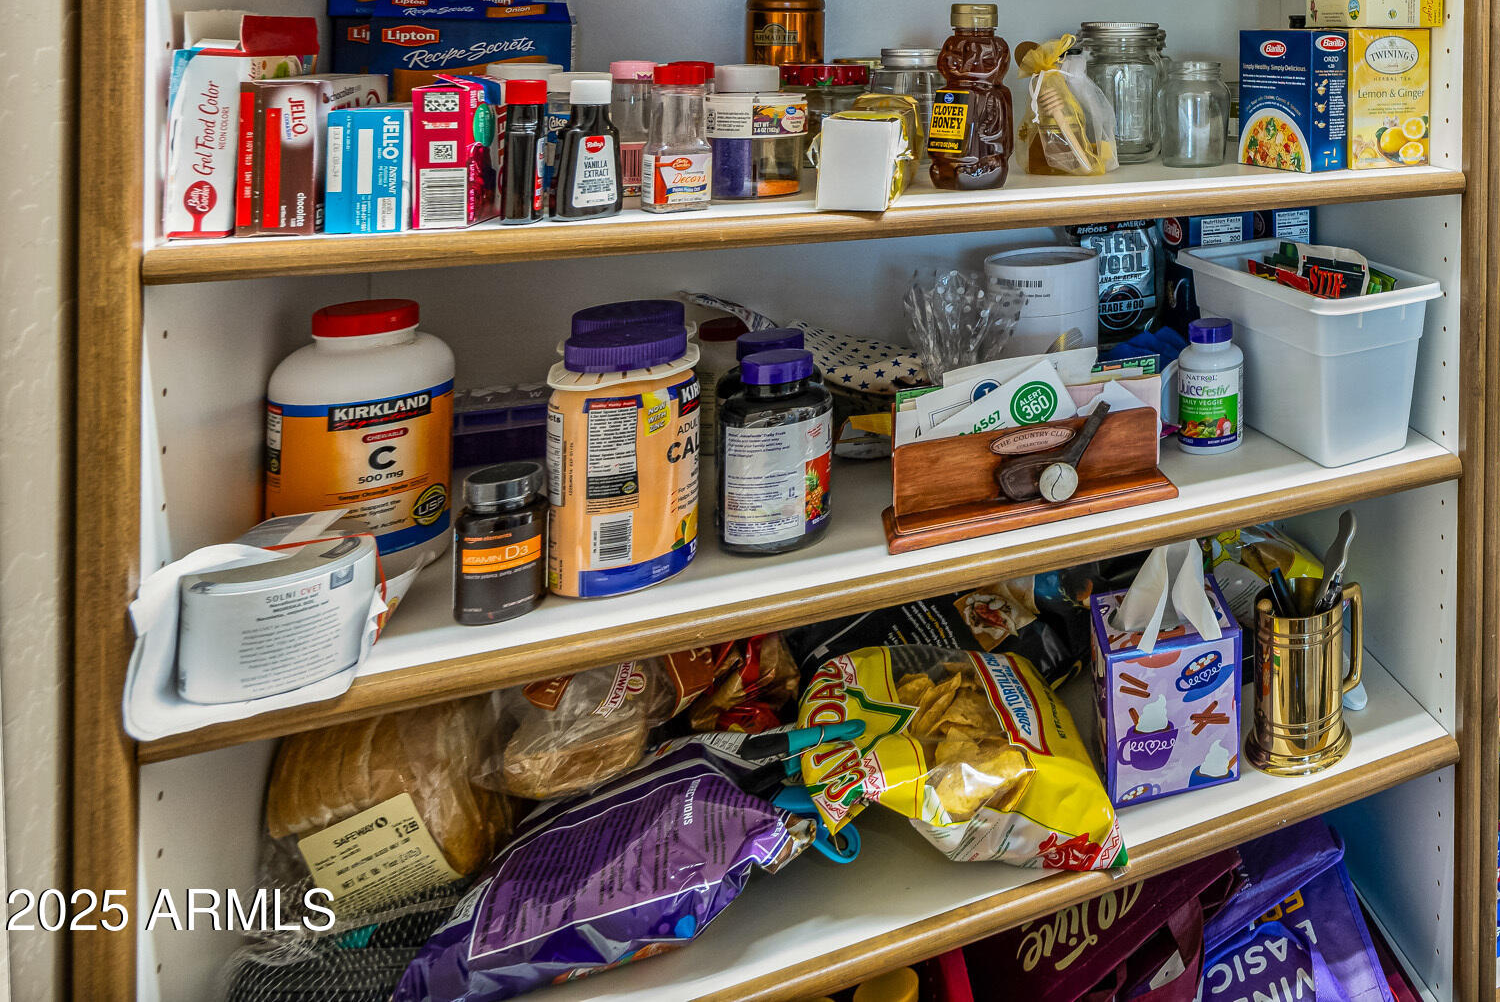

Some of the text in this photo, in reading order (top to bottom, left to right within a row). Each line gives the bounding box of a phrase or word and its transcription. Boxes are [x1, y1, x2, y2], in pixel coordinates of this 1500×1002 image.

[504, 5, 531, 13] Onion
[386, 30, 436, 42] Lipton
[1322, 37, 1345, 48] Barilla
[403, 37, 536, 69] Recipe Secrets
[1264, 44, 1285, 54] Barilla
[1369, 51, 1416, 62] TWININGS
[1357, 88, 1425, 100] Lemon Ginger
[933, 105, 964, 117] CLOVER
[192, 84, 220, 176] Gel Food Color
[932, 116, 963, 129] HONEY
[583, 160, 608, 169] VANILLA
[583, 169, 609, 179] EXTRACT
[672, 172, 707, 183] Decors
[187, 187, 200, 207] Betty
[197, 184, 212, 212] Crocker
[296, 192, 307, 227] chocolate
[1164, 218, 1180, 239] Barilla
[1089, 232, 1147, 254] STEEL
[1229, 234, 1241, 242] 200
[1186, 373, 1217, 381] NATROL
[1019, 388, 1043, 407] ALERT
[333, 394, 430, 422] KIRKLAND
[647, 401, 667, 416] NOW
[1021, 395, 1050, 420] 360
[647, 411, 667, 424] WITH
[649, 420, 666, 433] ZINC
[996, 430, 1049, 450] THE COUNTRY
[368, 445, 398, 470] C
[358, 470, 404, 485] 500 mg
[417, 497, 445, 516] USP
[504, 545, 529, 560] D3
[266, 582, 322, 604] SOLNI CVET
[992, 668, 1032, 736] CORN TORTILLA
[333, 823, 375, 848] SAFEWAY
